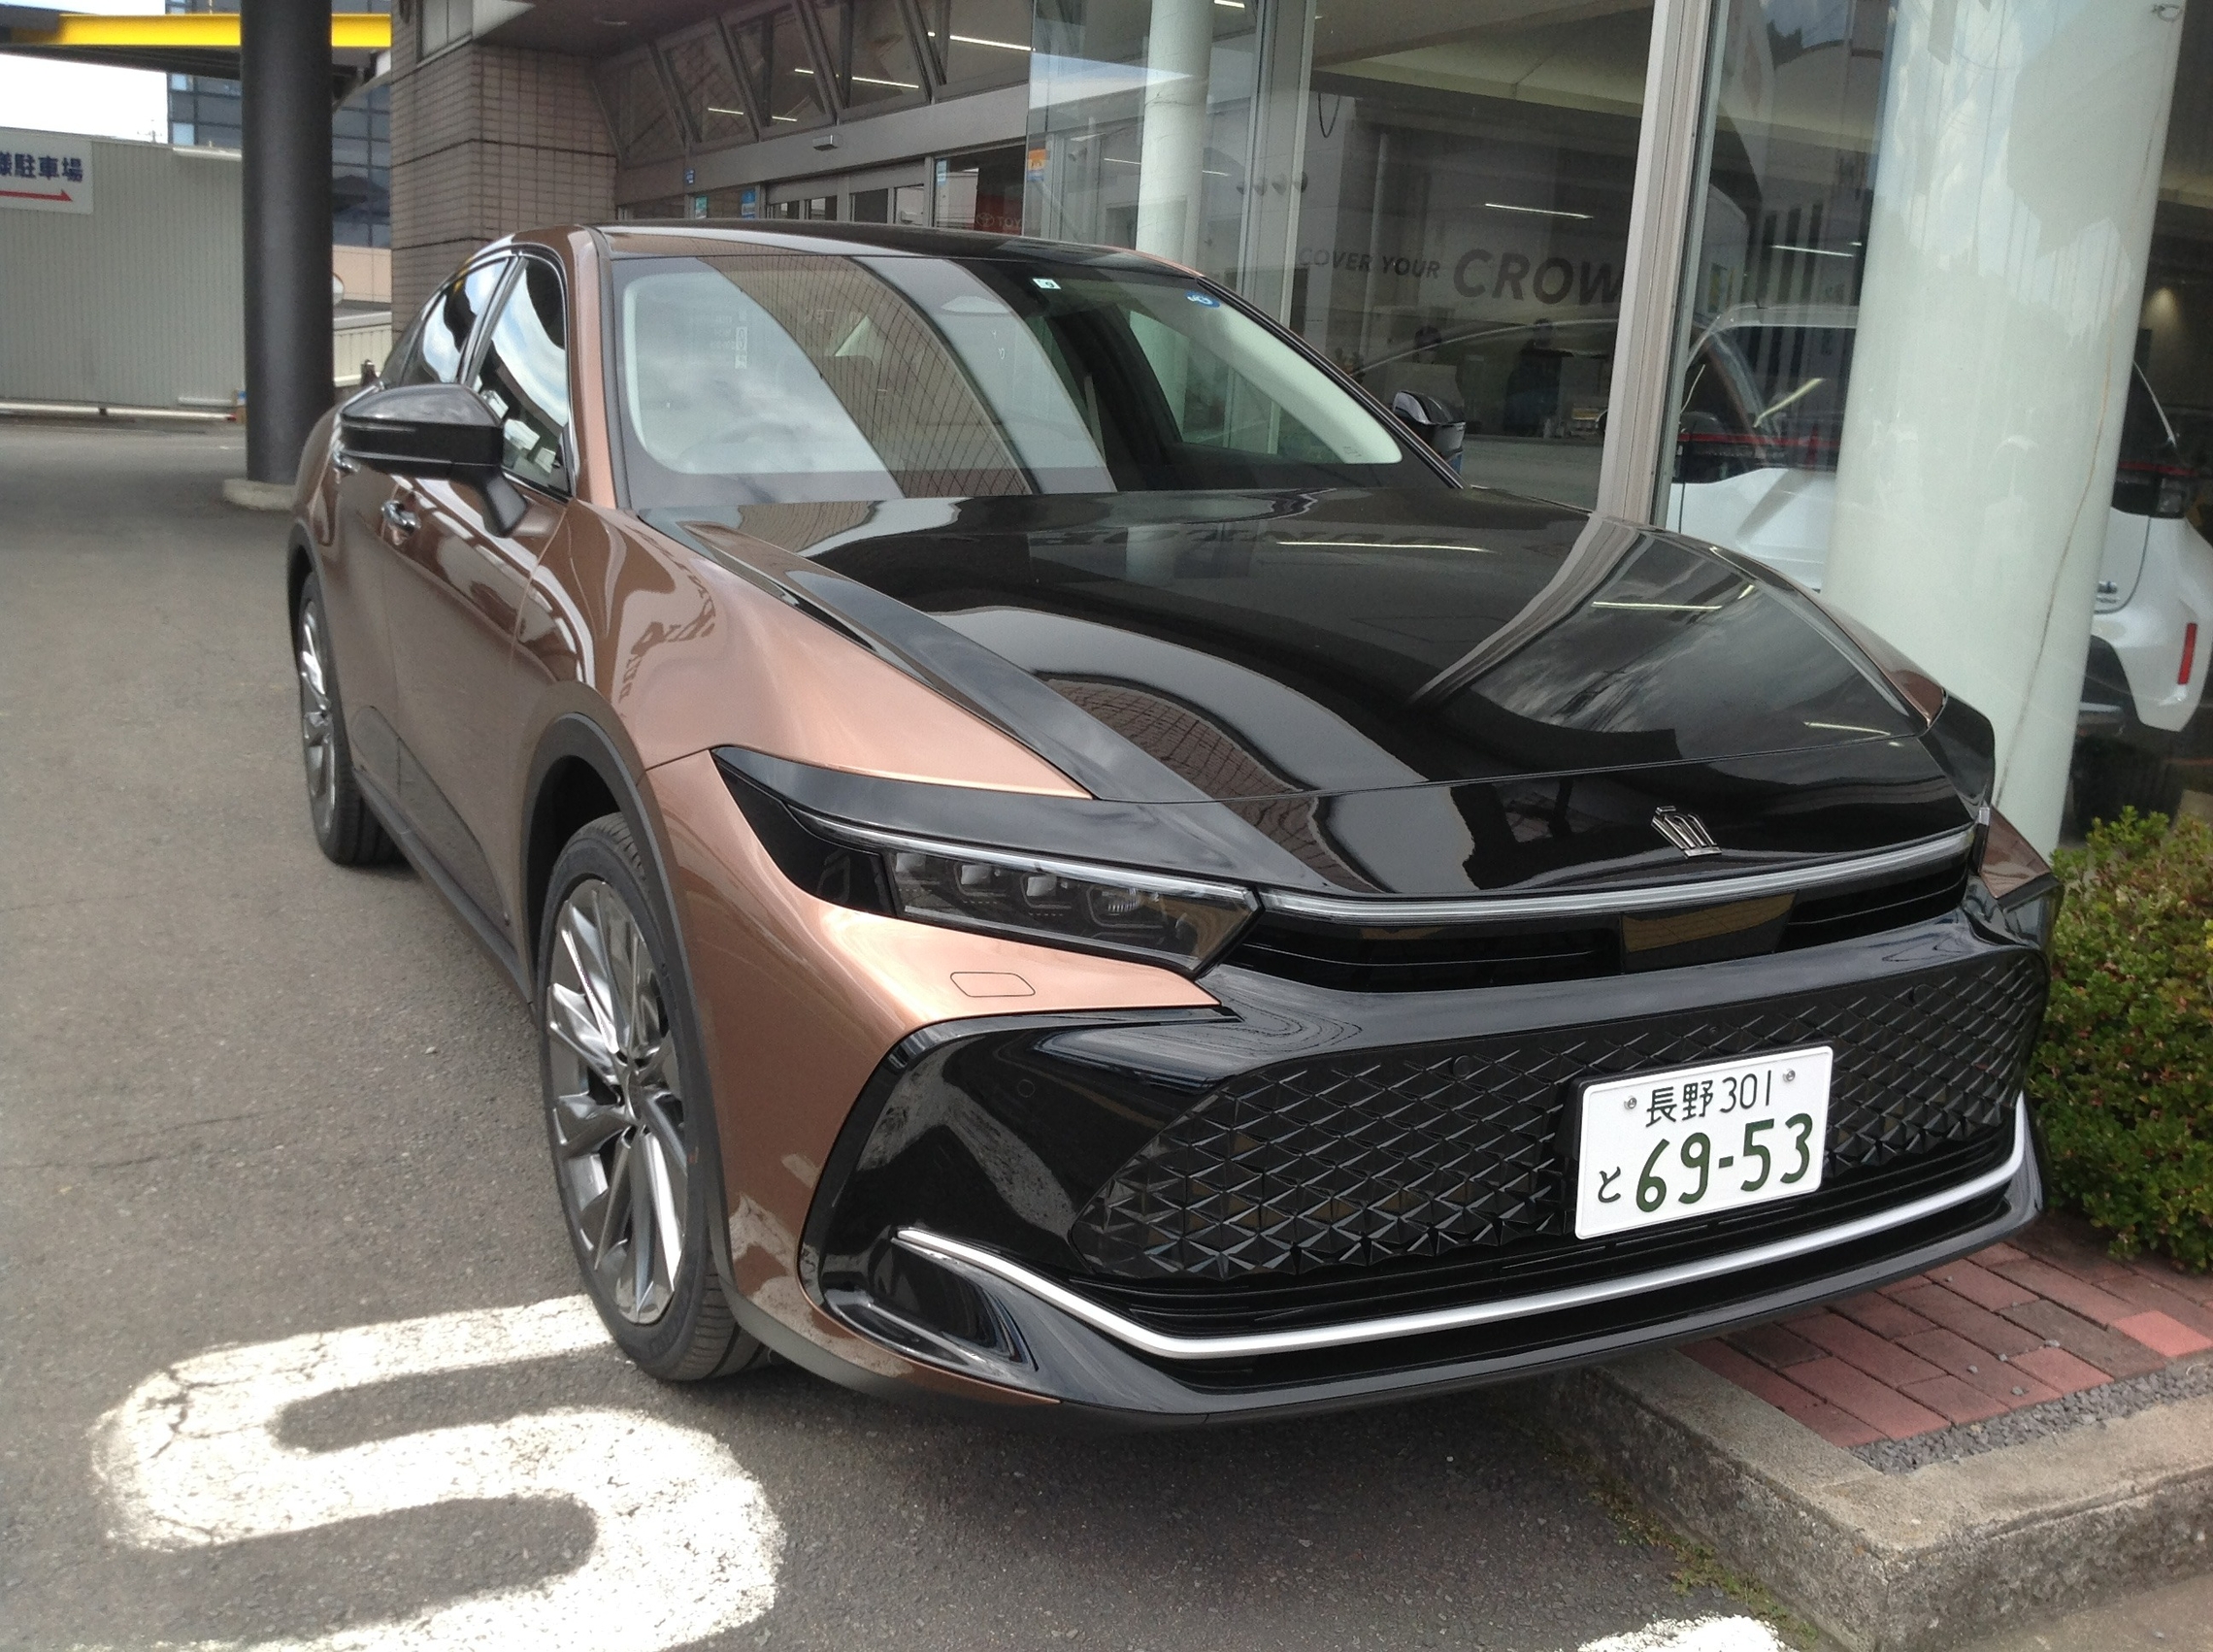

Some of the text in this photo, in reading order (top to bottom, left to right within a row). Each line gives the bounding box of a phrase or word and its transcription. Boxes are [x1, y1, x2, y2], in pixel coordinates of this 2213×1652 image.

[1382, 255, 1440, 279] YOUR
[1598, 1112, 1813, 1213] と 69-53
